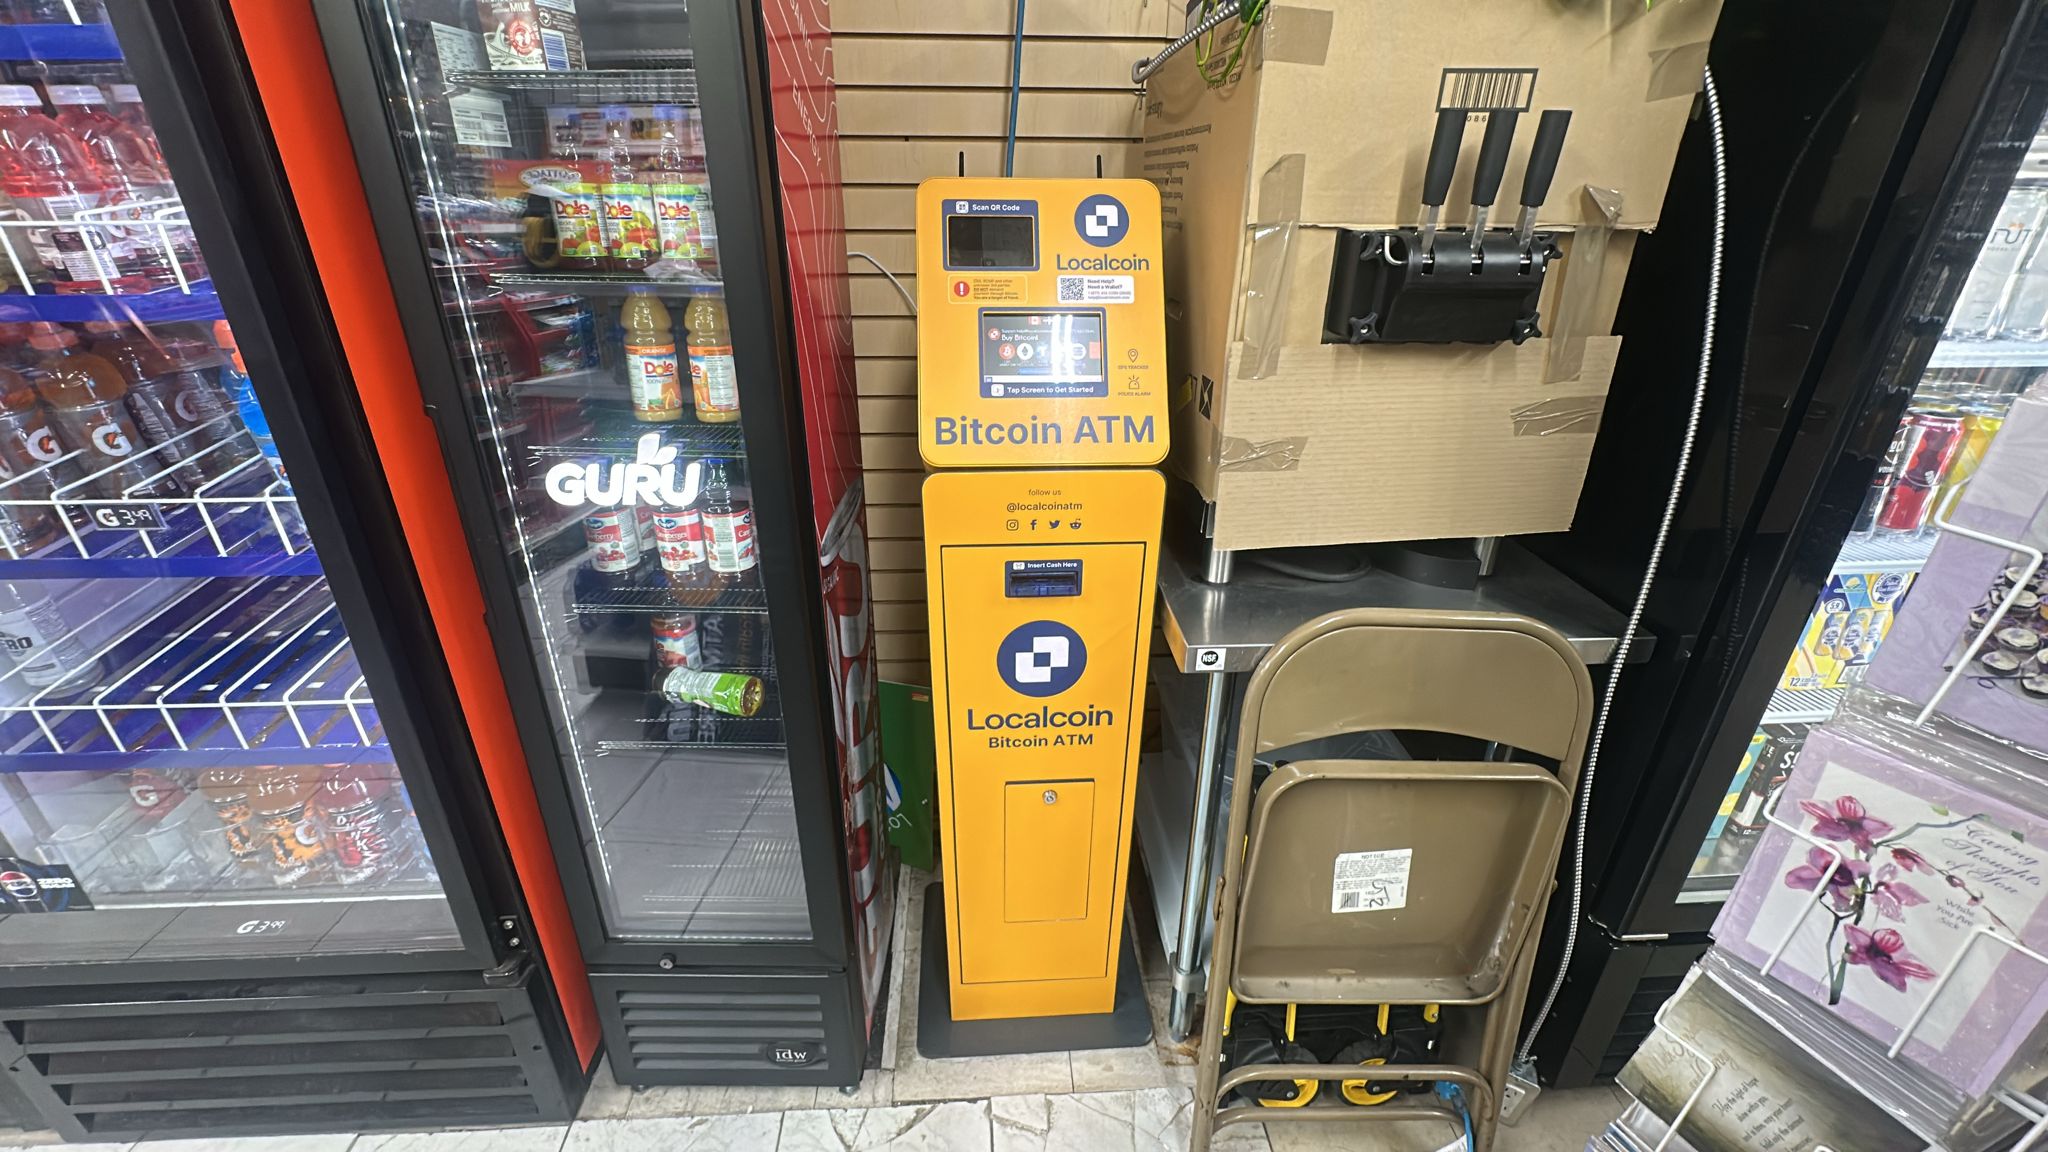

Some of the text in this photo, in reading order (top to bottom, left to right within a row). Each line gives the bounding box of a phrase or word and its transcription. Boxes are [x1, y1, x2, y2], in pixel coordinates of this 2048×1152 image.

[510, 2, 531, 12] MILK
[793, 78, 822, 167] ENERGY
[555, 200, 590, 217] Dole
[659, 201, 690, 217] Dole
[991, 204, 1002, 212] QR
[1056, 253, 1150, 271] Localcoin
[644, 361, 674, 376] Dole
[935, 415, 1154, 445] Bitcoin ATM
[27, 426, 62, 461] G
[92, 423, 133, 457] G
[545, 461, 701, 506] GURU
[1028, 488, 1050, 496] follow
[1006, 501, 1083, 512] @localcoinatm
[1203, 654, 1217, 663] NSF
[1790, 678, 1800, 686] 12
[967, 704, 1113, 731] Localcoin
[988, 734, 1094, 748] Bitcoin ATM
[1966, 824, 2039, 865] Caring
[1942, 838, 2041, 886] Thoughts
[1936, 905, 1974, 927] You Are
[1945, 898, 1975, 917] While
[1941, 917, 1960, 931] Sick
[776, 1049, 806, 1059] idw
